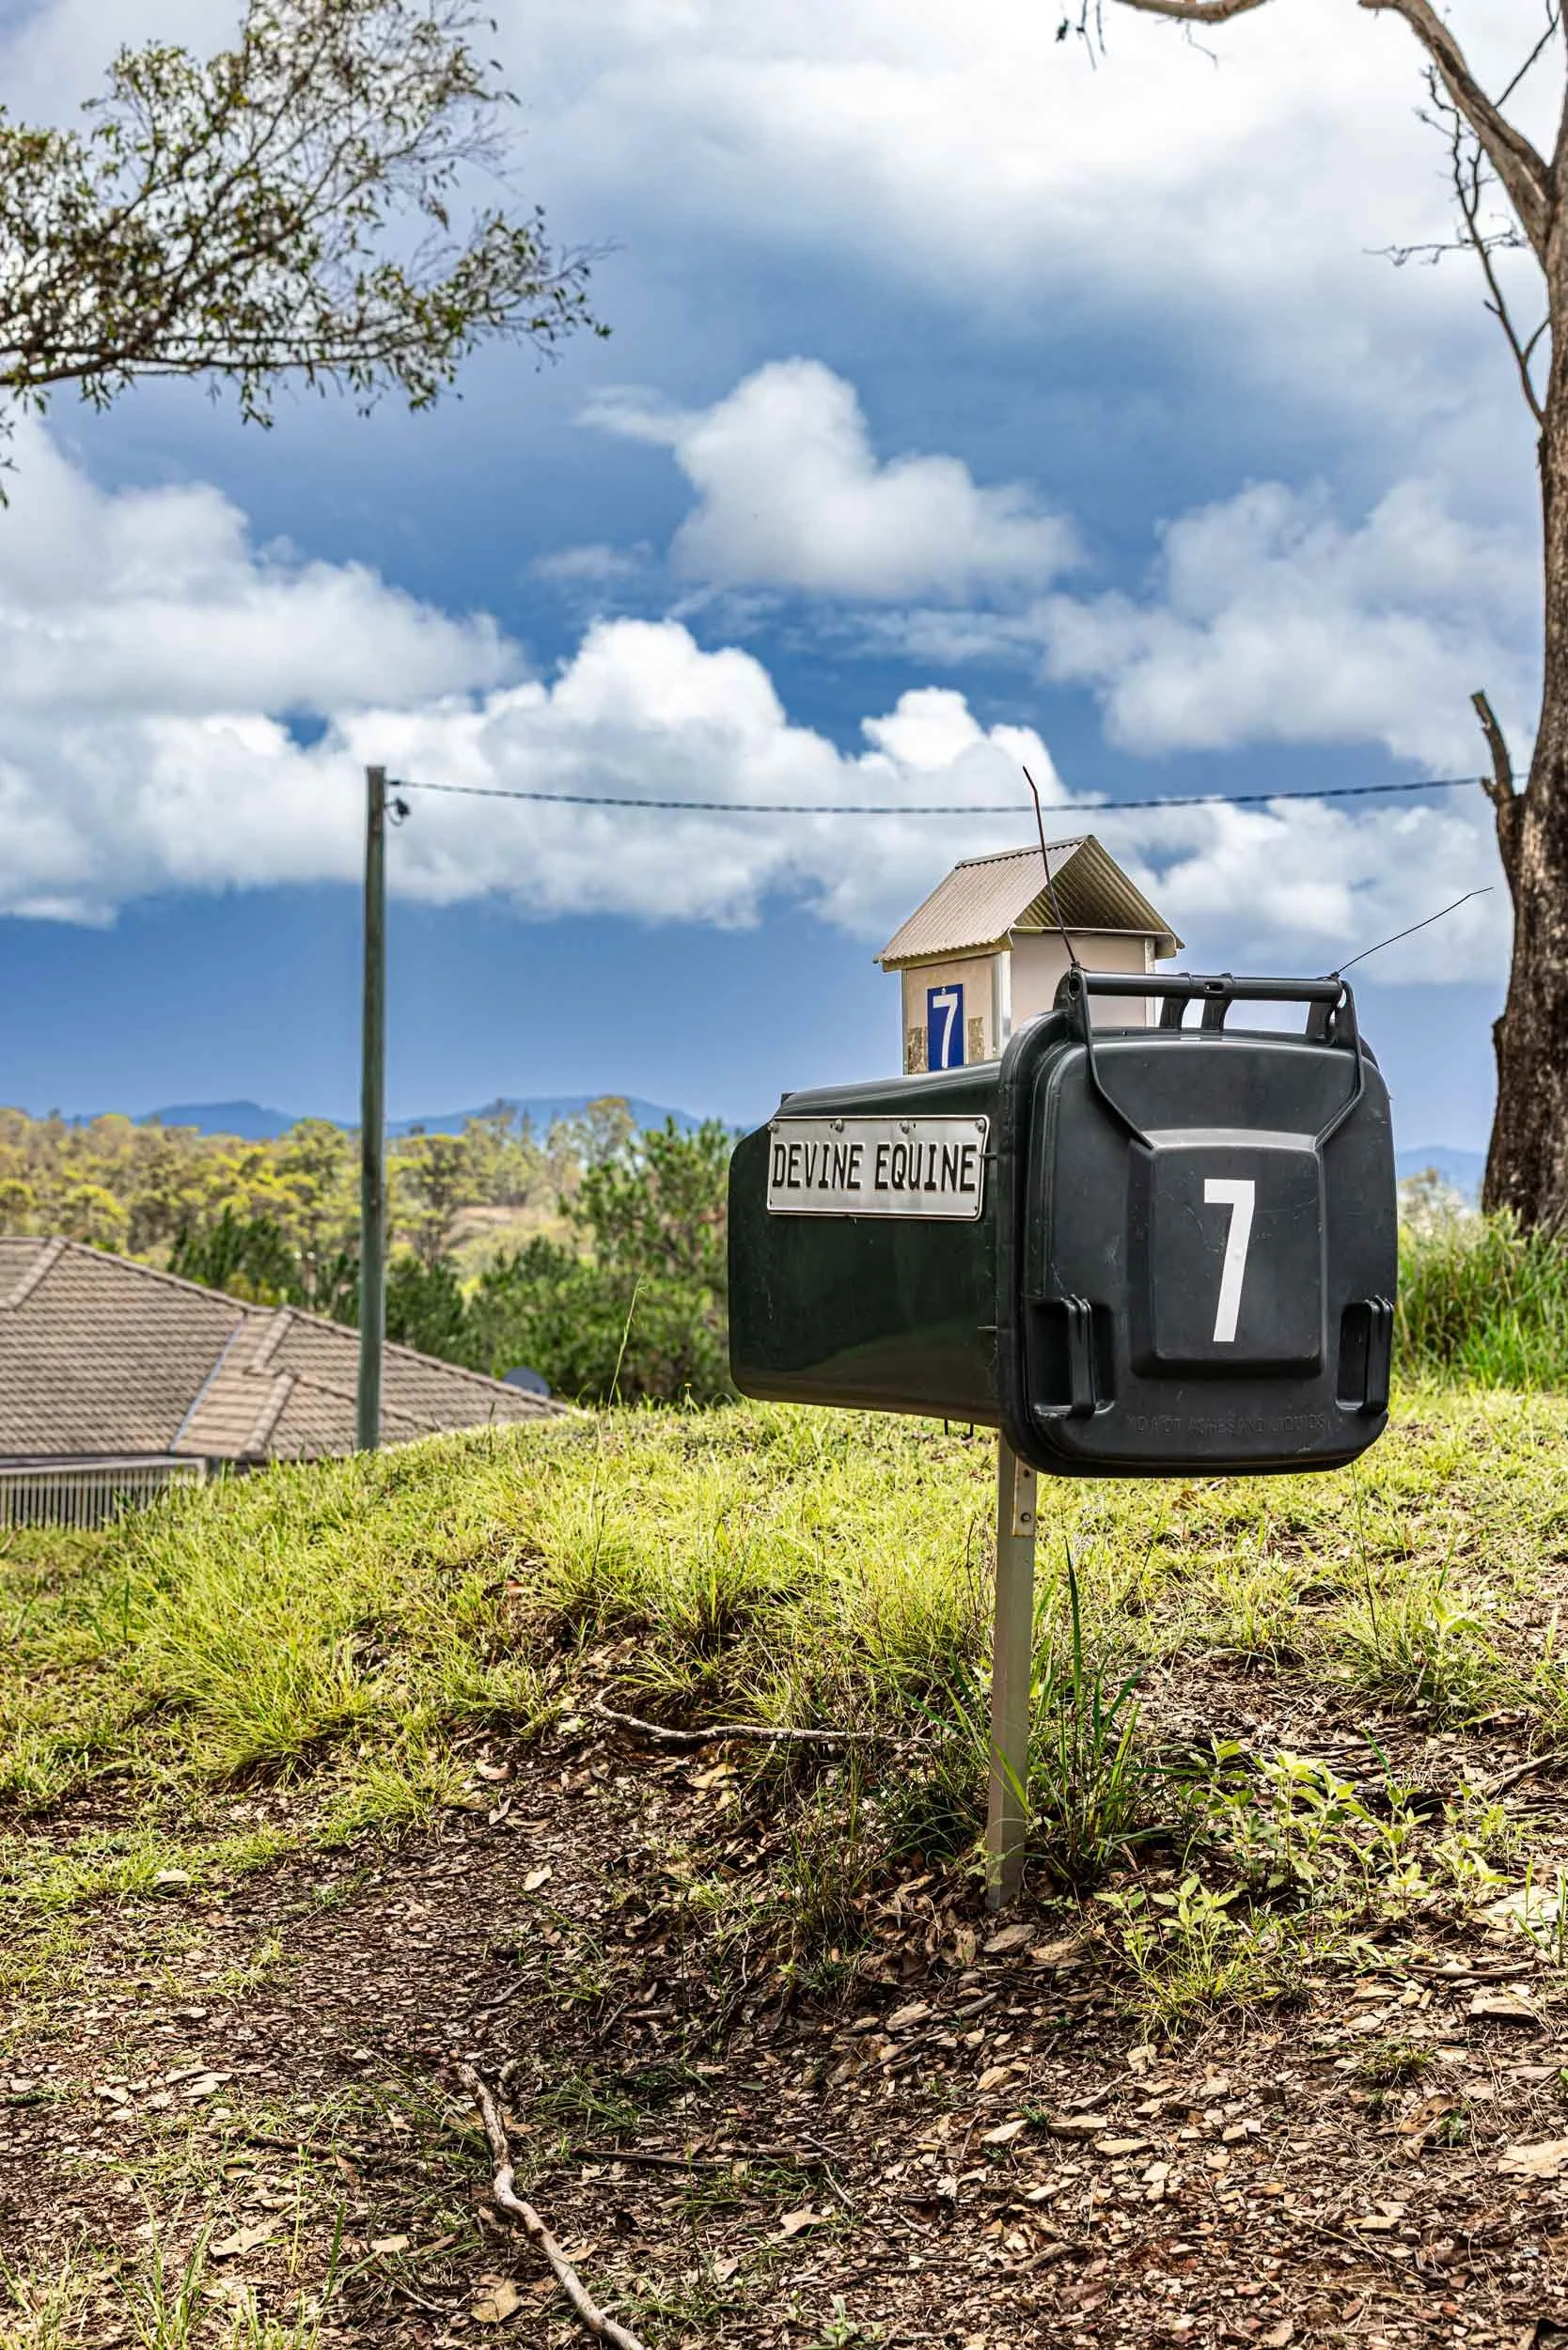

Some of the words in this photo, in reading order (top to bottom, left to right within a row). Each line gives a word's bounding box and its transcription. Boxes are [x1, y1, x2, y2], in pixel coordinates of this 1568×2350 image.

[933, 993, 958, 1070] 7
[772, 1143, 864, 1189] DEVINE
[875, 1143, 977, 1191] EQUINE
[1204, 1179, 1255, 1342] 7
